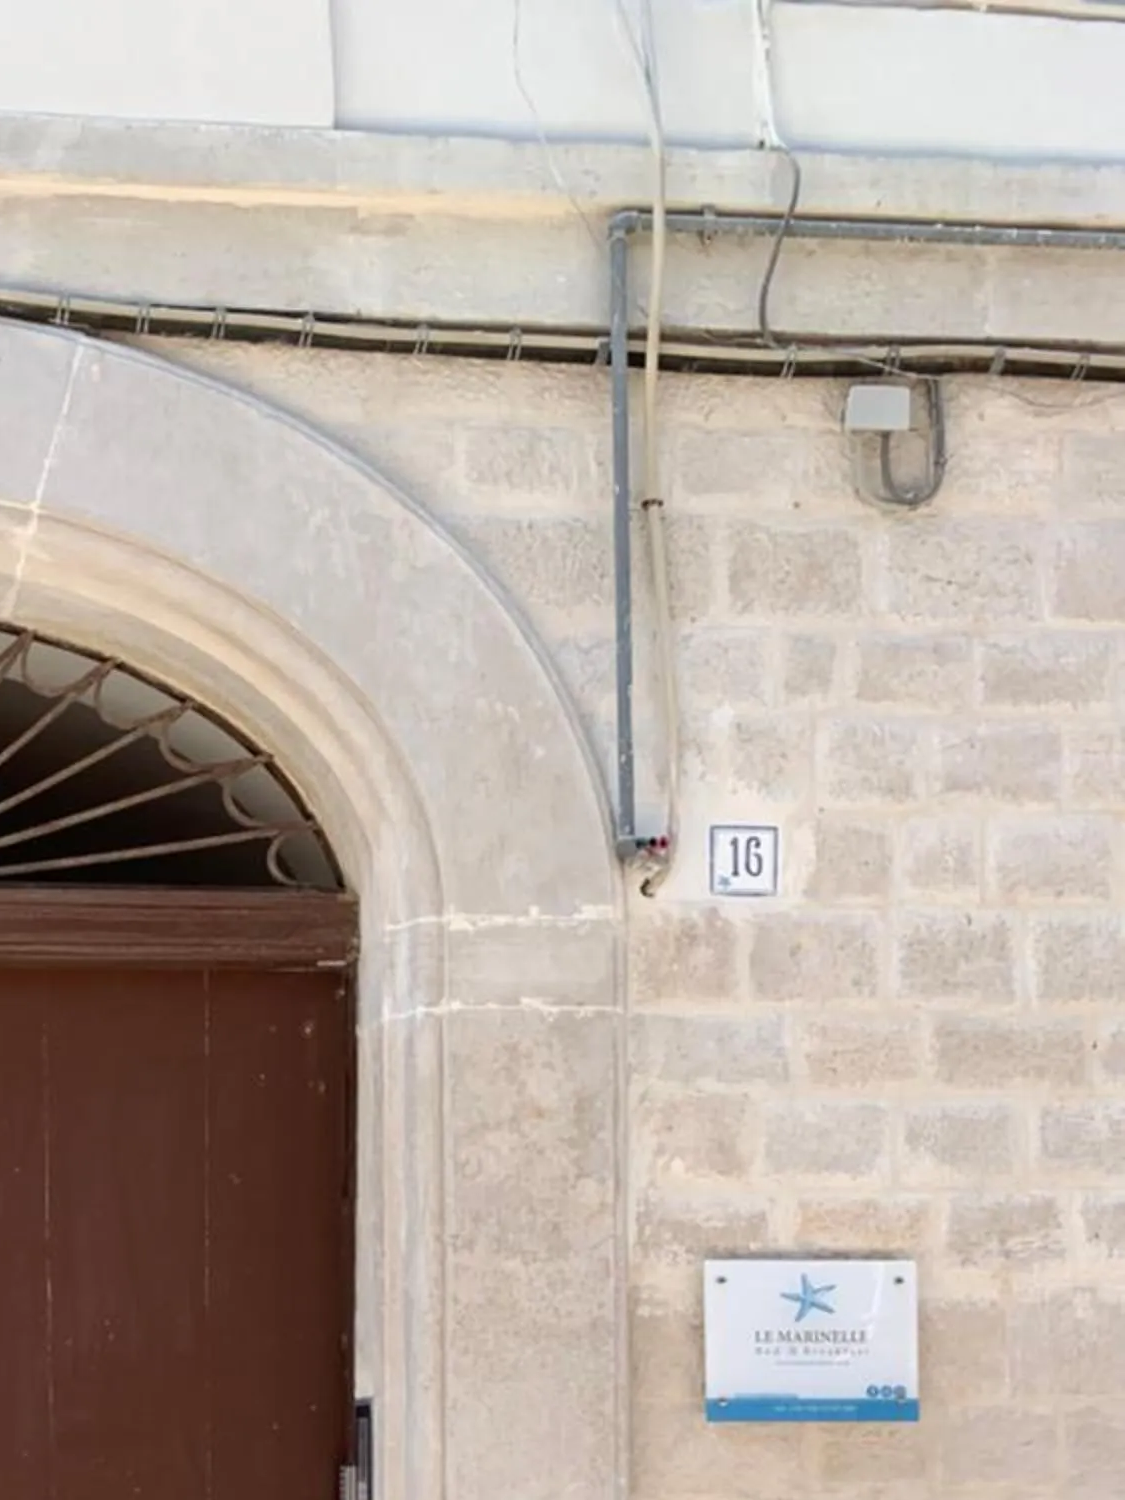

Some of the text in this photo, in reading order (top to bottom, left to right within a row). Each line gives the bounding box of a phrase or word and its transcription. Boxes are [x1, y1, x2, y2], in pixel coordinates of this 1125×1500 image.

[730, 836, 763, 877] 16
[754, 1330, 867, 1343] LE MARINELLE
